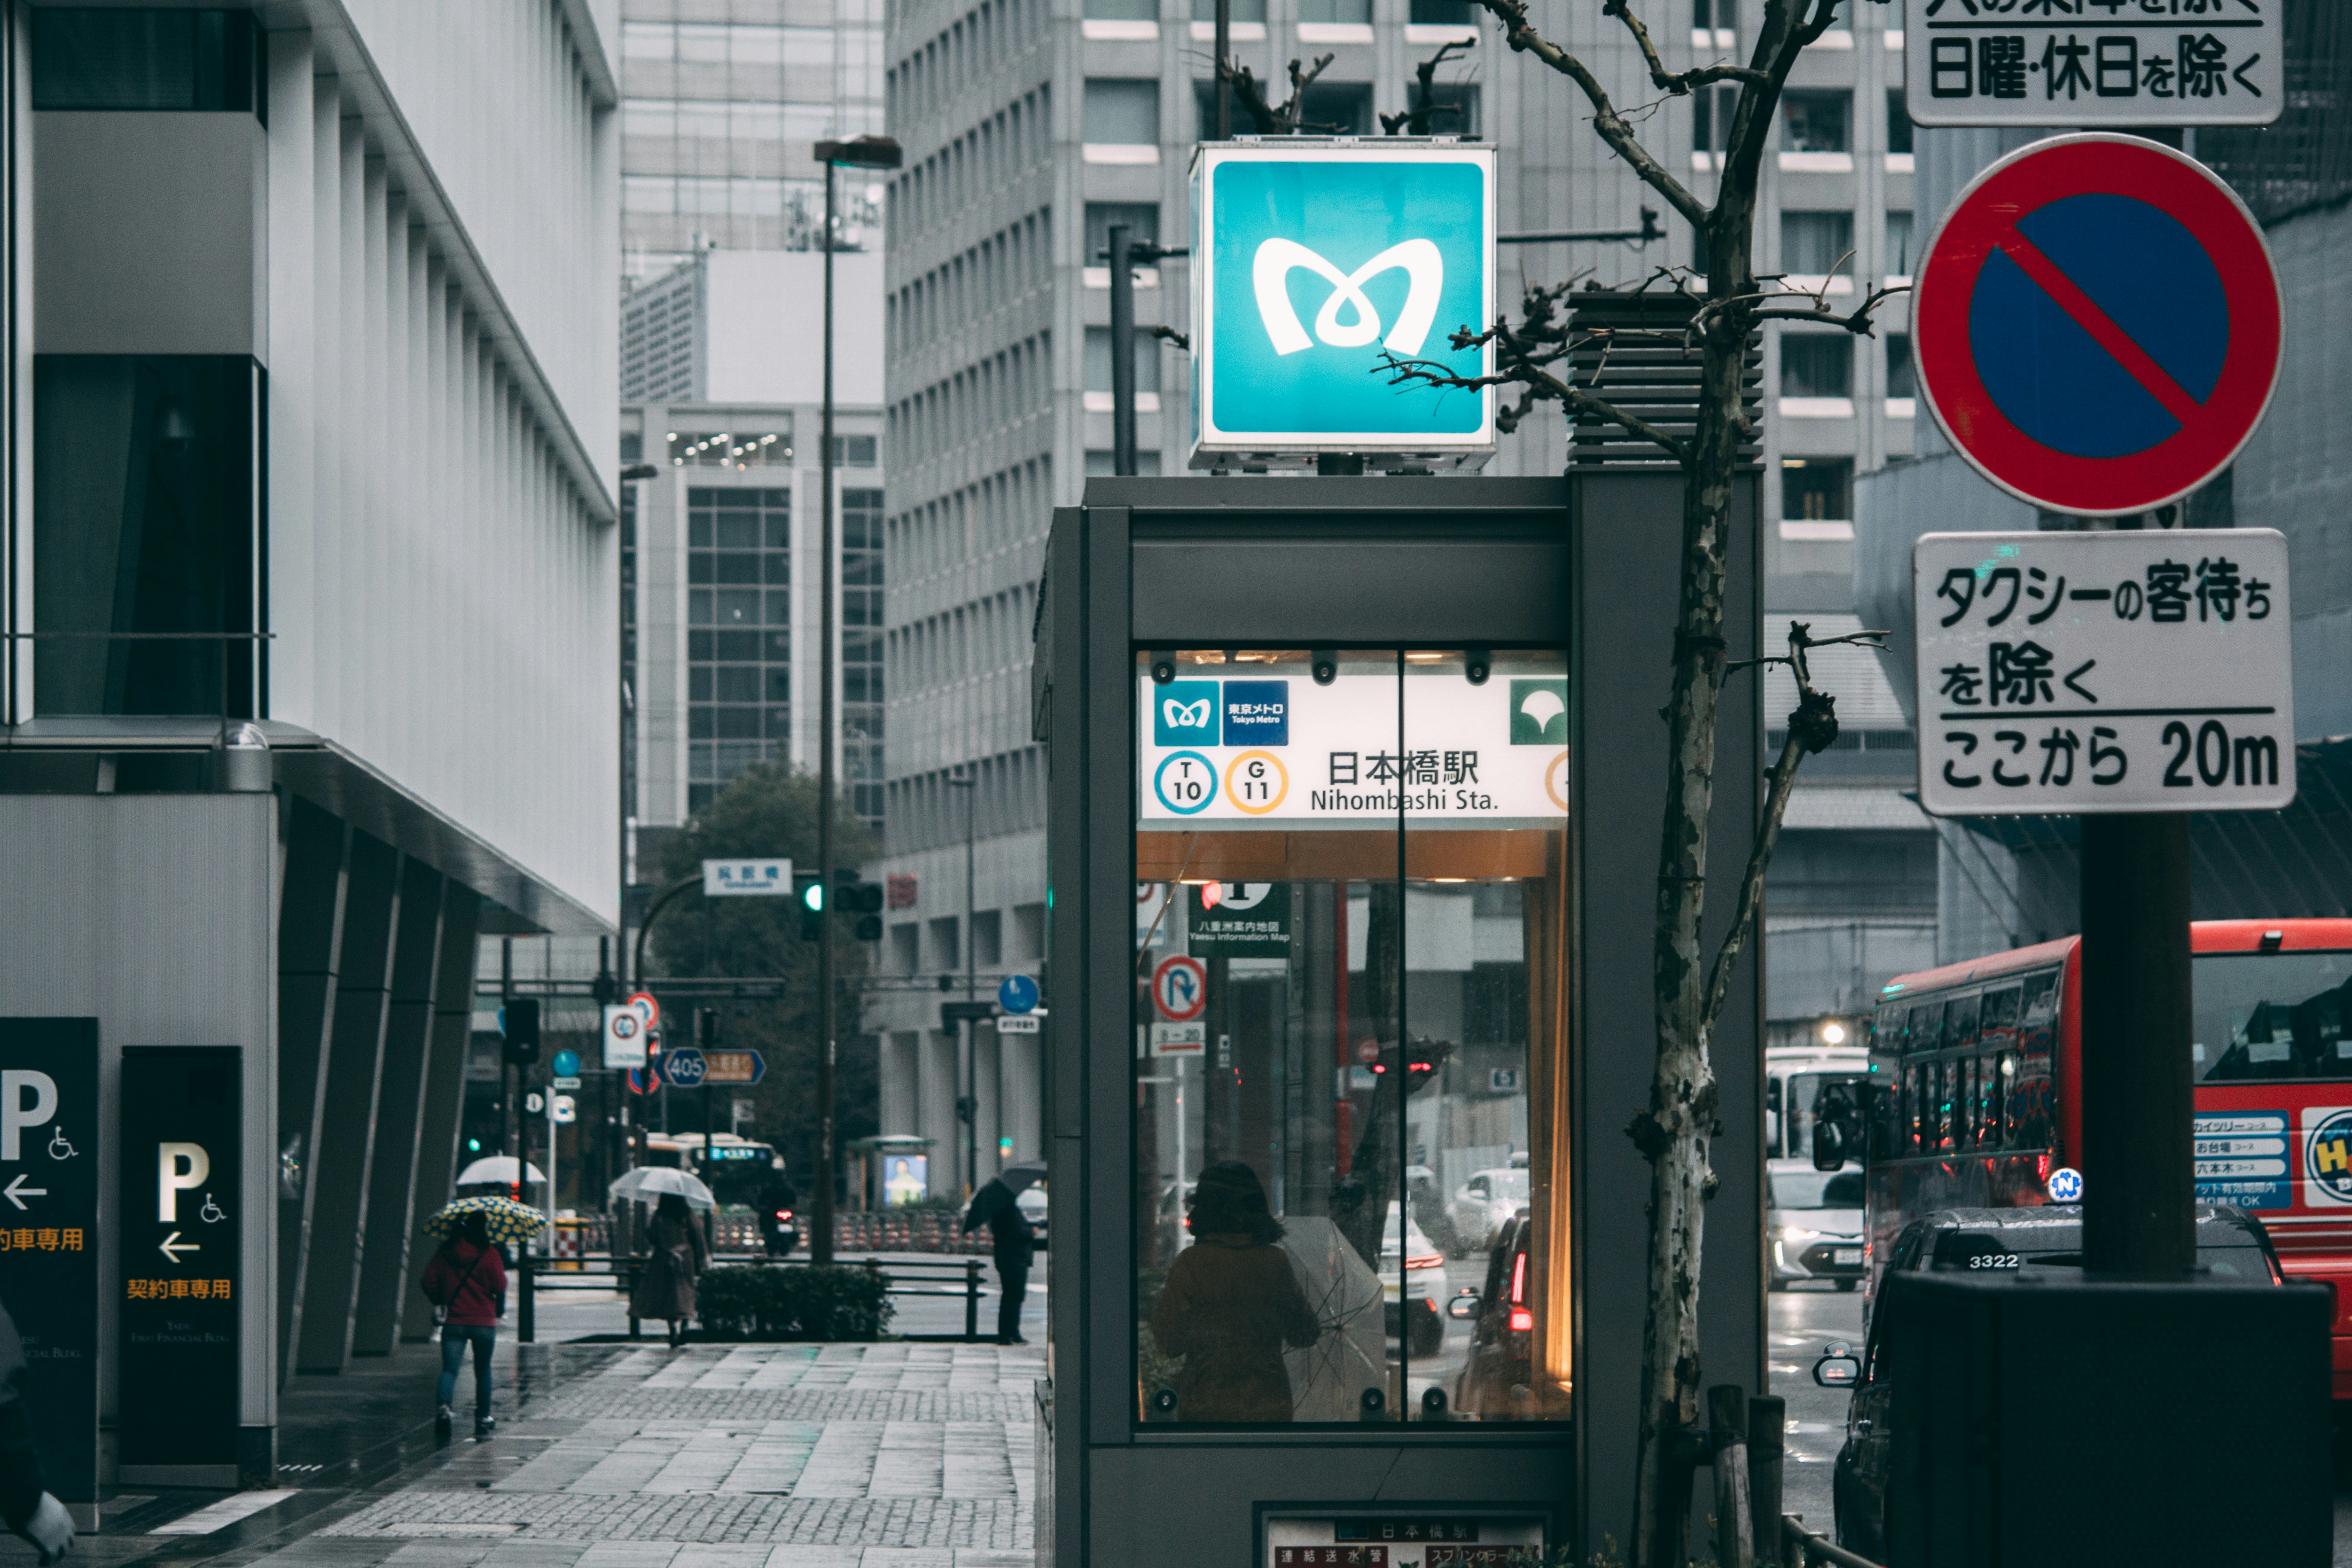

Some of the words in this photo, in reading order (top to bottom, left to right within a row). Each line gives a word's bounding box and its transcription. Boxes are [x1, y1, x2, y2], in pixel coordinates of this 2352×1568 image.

[1937, 557, 2271, 628] タクシーの客待ち
[1940, 640, 2098, 706] を除く
[1228, 704, 1283, 714] 東京メトロ
[1232, 716, 1255, 725] Tokyo
[1943, 727, 2127, 788] ここから
[2162, 720, 2279, 788] 20m
[1329, 750, 1479, 785] 日本橋駅
[1174, 781, 1202, 800] 10
[1244, 781, 1268, 800] 11
[1312, 788, 1446, 810] Nihombashi
[1456, 789, 1498, 810] Sta.
[1199, 921, 1280, 933] 八重洲案内地図
[1271, 933, 1290, 943] Map
[670, 1057, 703, 1077] 405
[1, 1069, 58, 1161] P
[159, 1142, 210, 1222] P
[1969, 1254, 2018, 1269] 3322
[127, 1279, 231, 1299] 契約車専用
